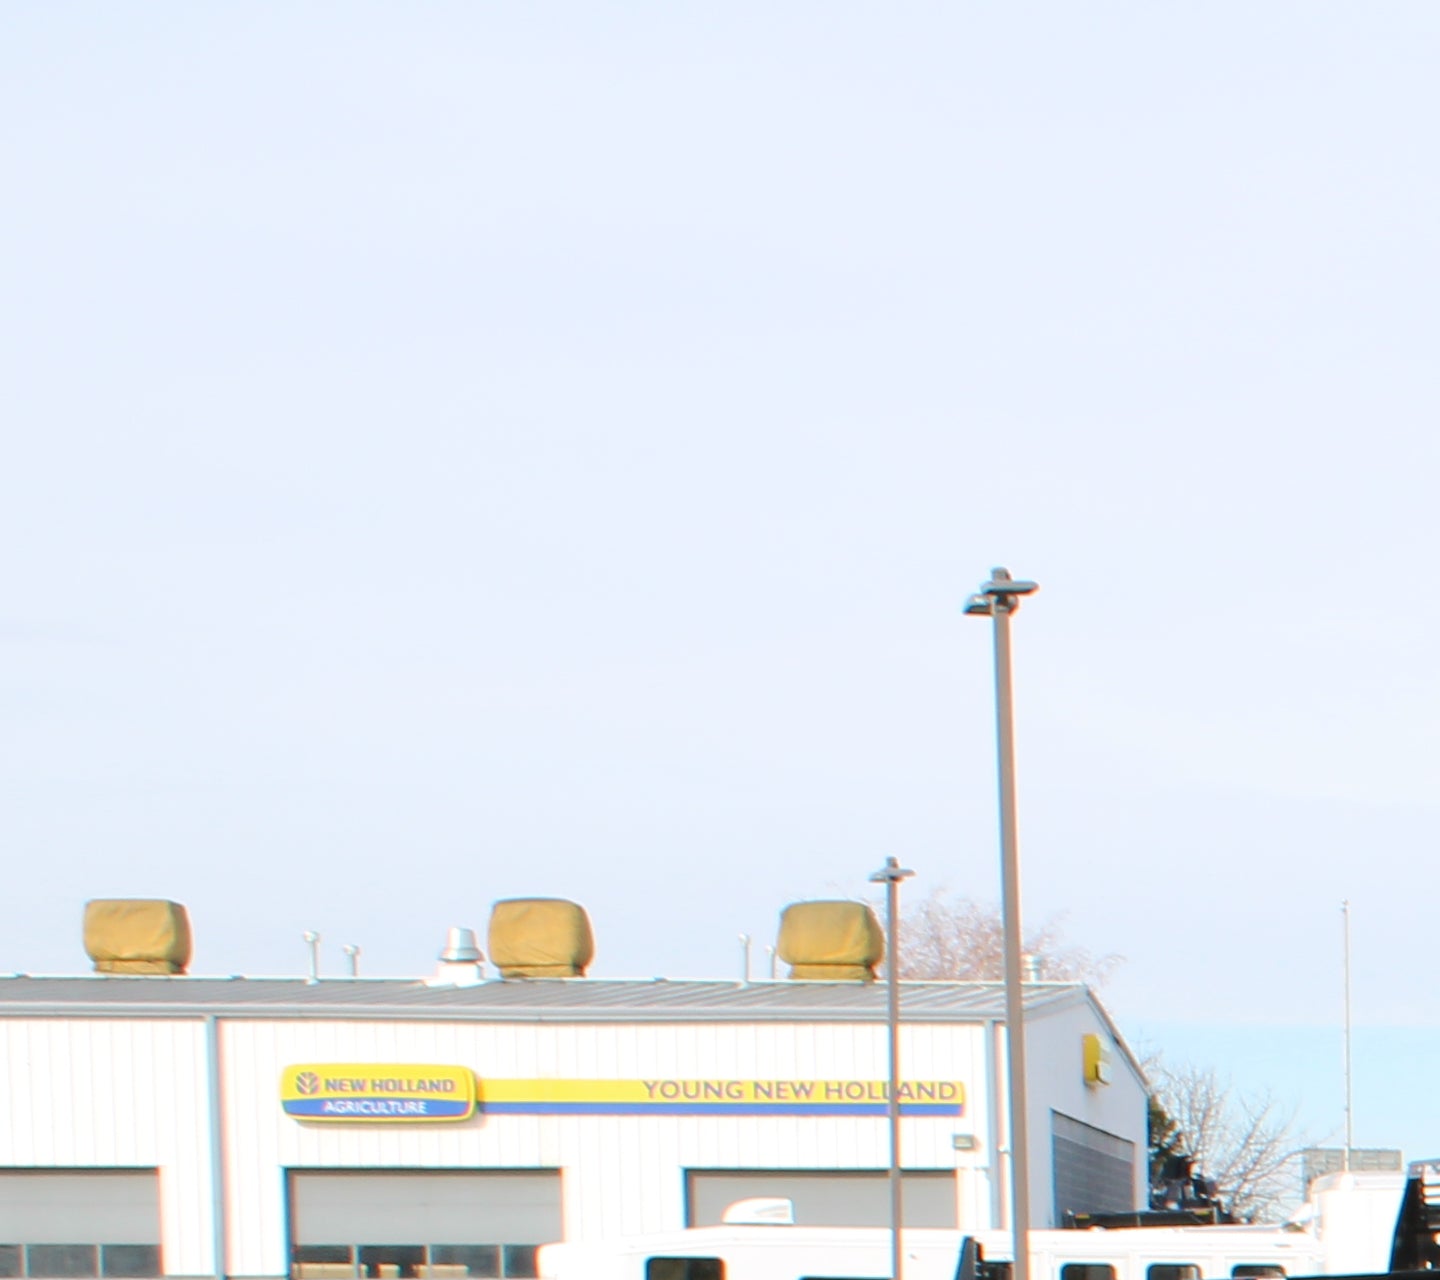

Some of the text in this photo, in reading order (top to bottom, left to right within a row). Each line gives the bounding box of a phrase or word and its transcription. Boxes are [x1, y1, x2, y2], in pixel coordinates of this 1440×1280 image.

[325, 1078, 456, 1093] NEW HOLLAND
[643, 1080, 957, 1101] YOUNG NEW HOLLAND
[323, 1101, 427, 1114] AGRICULTURE
